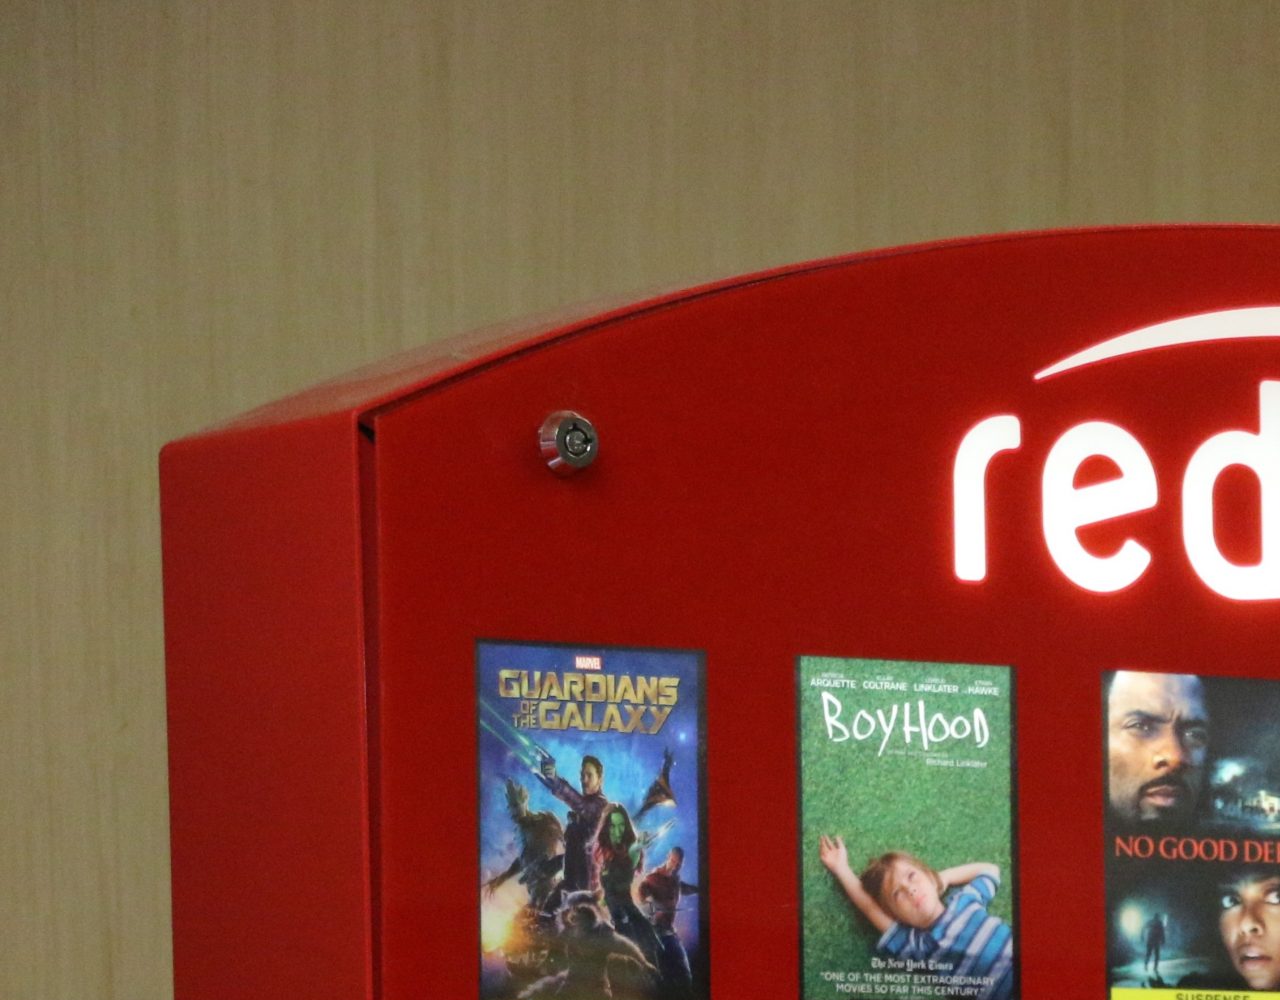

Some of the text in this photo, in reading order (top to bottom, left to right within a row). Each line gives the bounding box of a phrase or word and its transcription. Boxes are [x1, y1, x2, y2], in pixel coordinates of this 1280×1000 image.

[575, 656, 601, 670] MARVEL
[499, 669, 681, 705] GUARDIANS
[810, 678, 999, 697] ARQUETTE COLTRANE LINKLATER HAWKE
[520, 700, 538, 713] OF
[512, 714, 538, 728] THE
[538, 700, 673, 735] GALAXY
[1115, 836, 1154, 858] NO
[1159, 837, 1238, 861] GOOD
[871, 957, 954, 972] The New York Times
[847, 972, 860, 982] OF
[864, 973, 882, 983] THE
[884, 973, 911, 984] MOST
[913, 974, 996, 986] EXTRAORDINARY
[836, 983, 872, 993] MOVIES
[874, 984, 888, 994] SO
[890, 985, 909, 994] FAR
[911, 985, 933, 995] THIS
